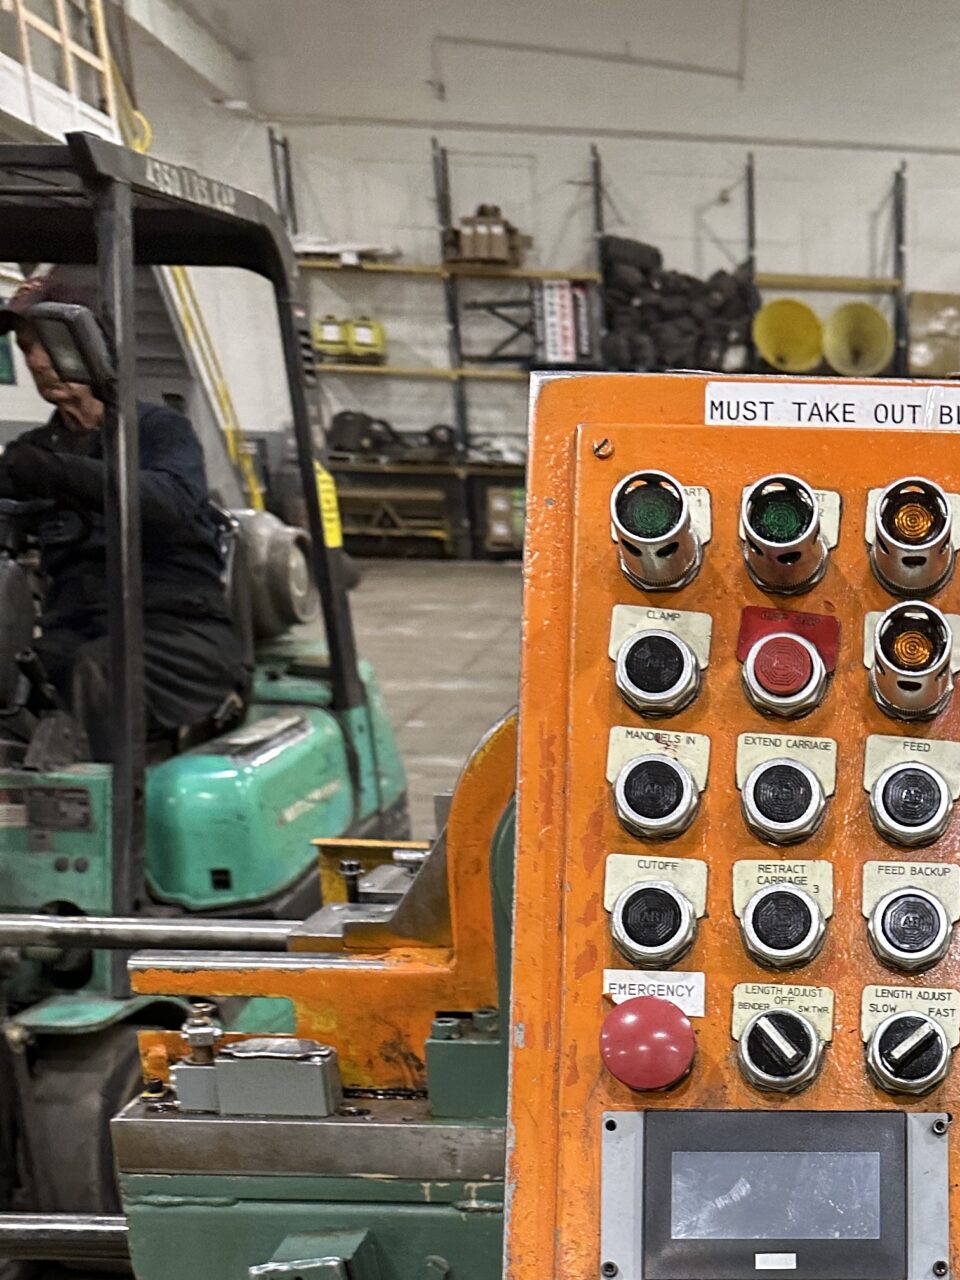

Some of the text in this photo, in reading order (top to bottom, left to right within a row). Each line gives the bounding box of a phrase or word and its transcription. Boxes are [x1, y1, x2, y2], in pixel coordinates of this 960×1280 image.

[709, 400, 775, 421] MUST
[792, 402, 855, 423] TAKE
[874, 403, 922, 424] OUT
[646, 610, 681, 621] CLAMP
[626, 730, 696, 744] MANDELS IN
[744, 737, 832, 751] EXTEND CARRIAGE
[903, 741, 930, 753] FEED
[637, 860, 679, 871] CUTOFF
[758, 864, 806, 874] RETRACT
[878, 865, 951, 877] FEED BACKUP
[757, 876, 808, 885] CARRIAGE
[813, 885, 819, 894] 3
[609, 983, 695, 997] EMERGENCY
[745, 985, 823, 998] LENGTH ADJUST
[875, 989, 952, 1000] LENGTH ADJUST
[738, 1002, 770, 1010] BENDER
[774, 996, 795, 1005] OFF
[869, 1004, 956, 1017] SLOW FAST
